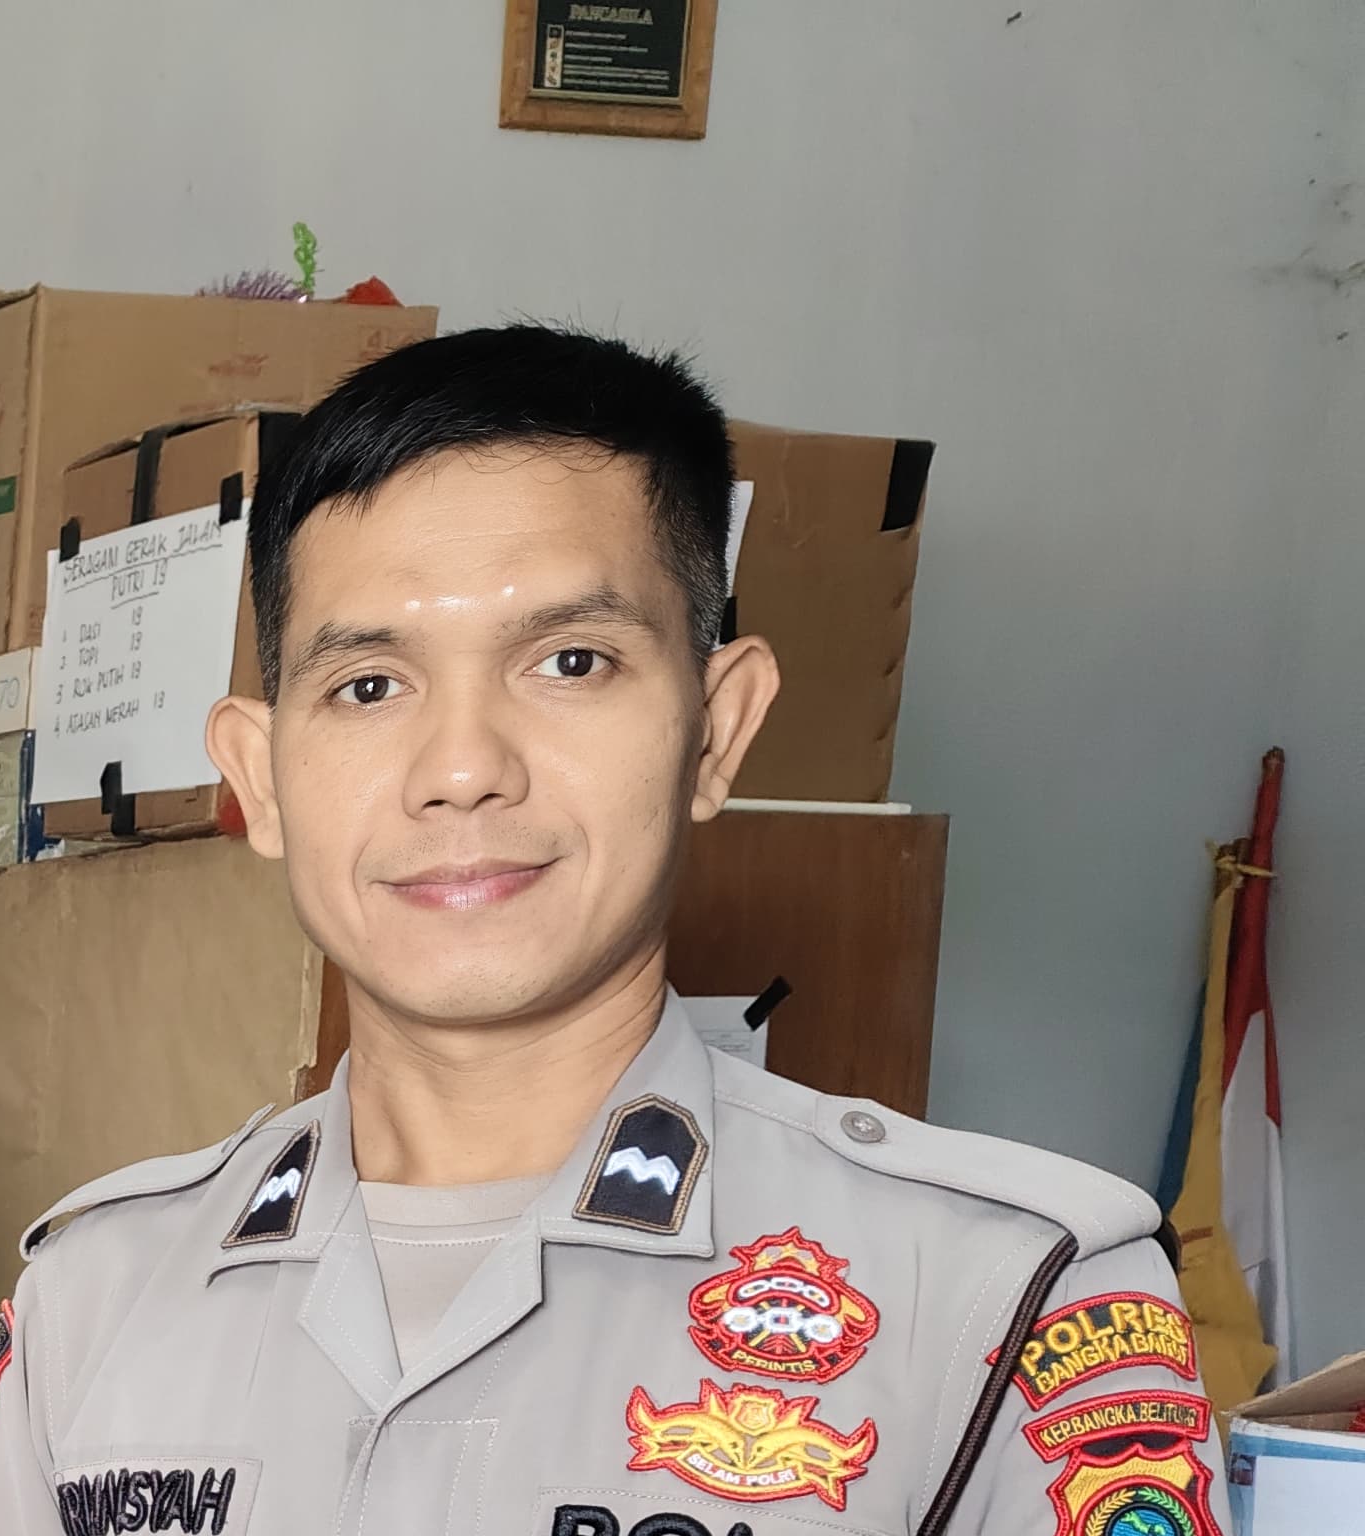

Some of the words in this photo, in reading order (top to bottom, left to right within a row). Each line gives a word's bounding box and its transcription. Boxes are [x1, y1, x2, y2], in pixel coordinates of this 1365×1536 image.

[125, 535, 168, 565] GERAK
[173, 519, 222, 552] JALAN
[111, 569, 145, 601] PUTRI
[78, 647, 99, 667] TOPI
[96, 665, 125, 693] PUTIH
[104, 699, 140, 726] MERAH
[1020, 1302, 1188, 1376] POLRES
[731, 1349, 817, 1374] PERINTIS
[1035, 1334, 1130, 1394] BANGKA
[686, 1453, 741, 1485] SELAM
[745, 1467, 797, 1486] POLRI
